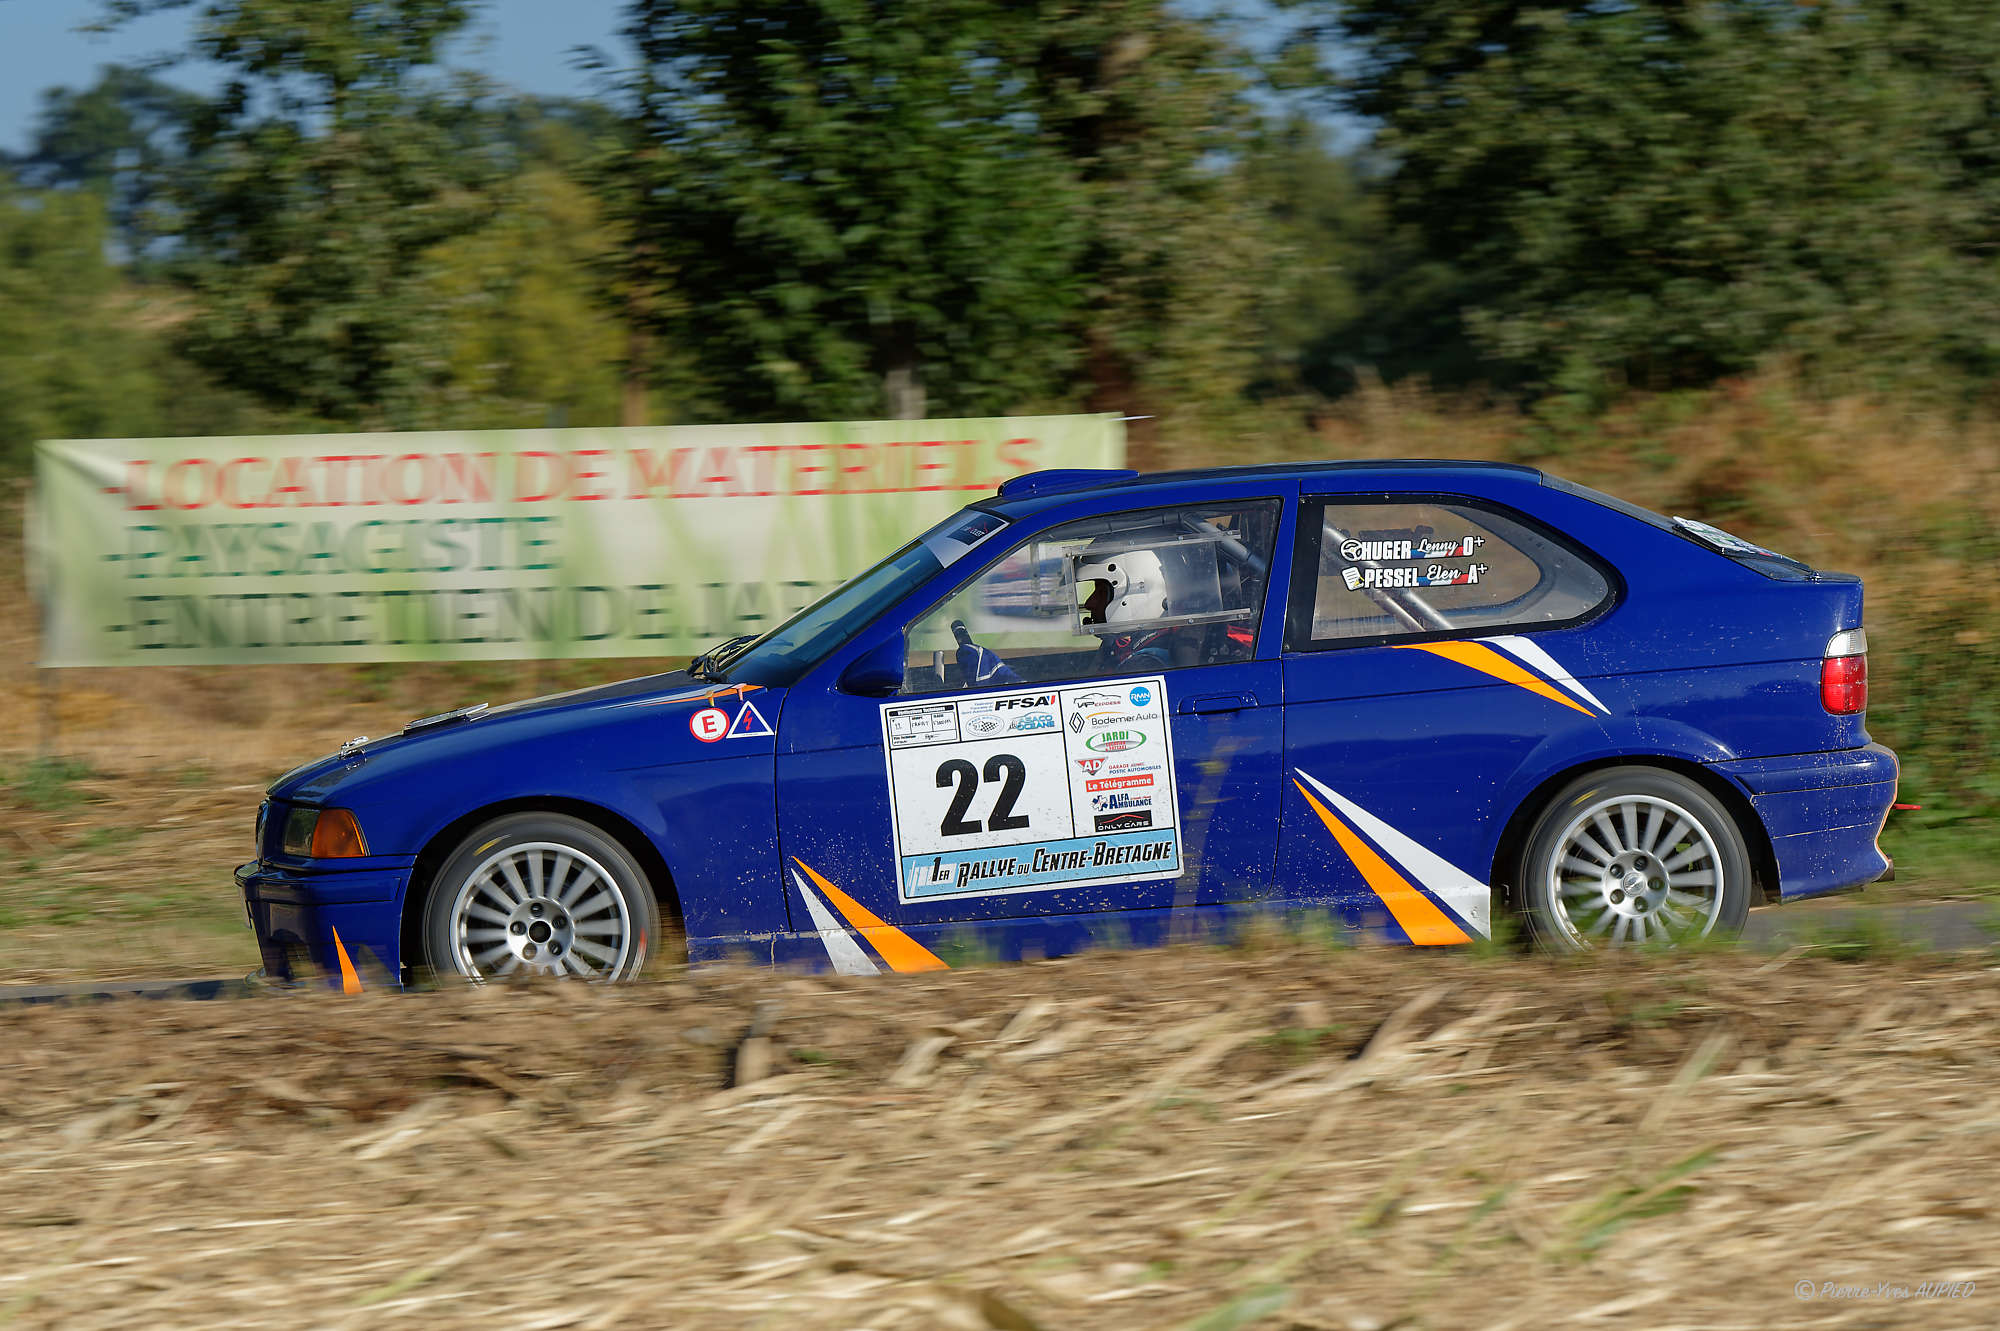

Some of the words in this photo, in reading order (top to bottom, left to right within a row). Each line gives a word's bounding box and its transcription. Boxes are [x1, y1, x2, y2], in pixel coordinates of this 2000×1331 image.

[513, 448, 616, 502] DE
[1360, 540, 1412, 561] HUGER
[1417, 538, 1459, 556] Lenny
[1363, 567, 1419, 588] PESSEL
[1426, 564, 1462, 581] Elen
[1467, 564, 1488, 584] A+
[568, 583, 677, 642] DE
[995, 696, 1049, 710] FFSA
[1130, 693, 1151, 703] RMN
[701, 715, 717, 733] E
[1102, 731, 1129, 742] JARDI
[1083, 760, 1102, 771] AD
[1100, 778, 1151, 789] Télégramme
[936, 754, 1029, 836] 22
[1097, 823, 1123, 831] ONLY
[1124, 820, 1149, 828] CARS
[956, 858, 1018, 888] RALLYE
[1017, 863, 1030, 875] DU
[1031, 840, 1174, 874] CENTRE-BRETAGNE
